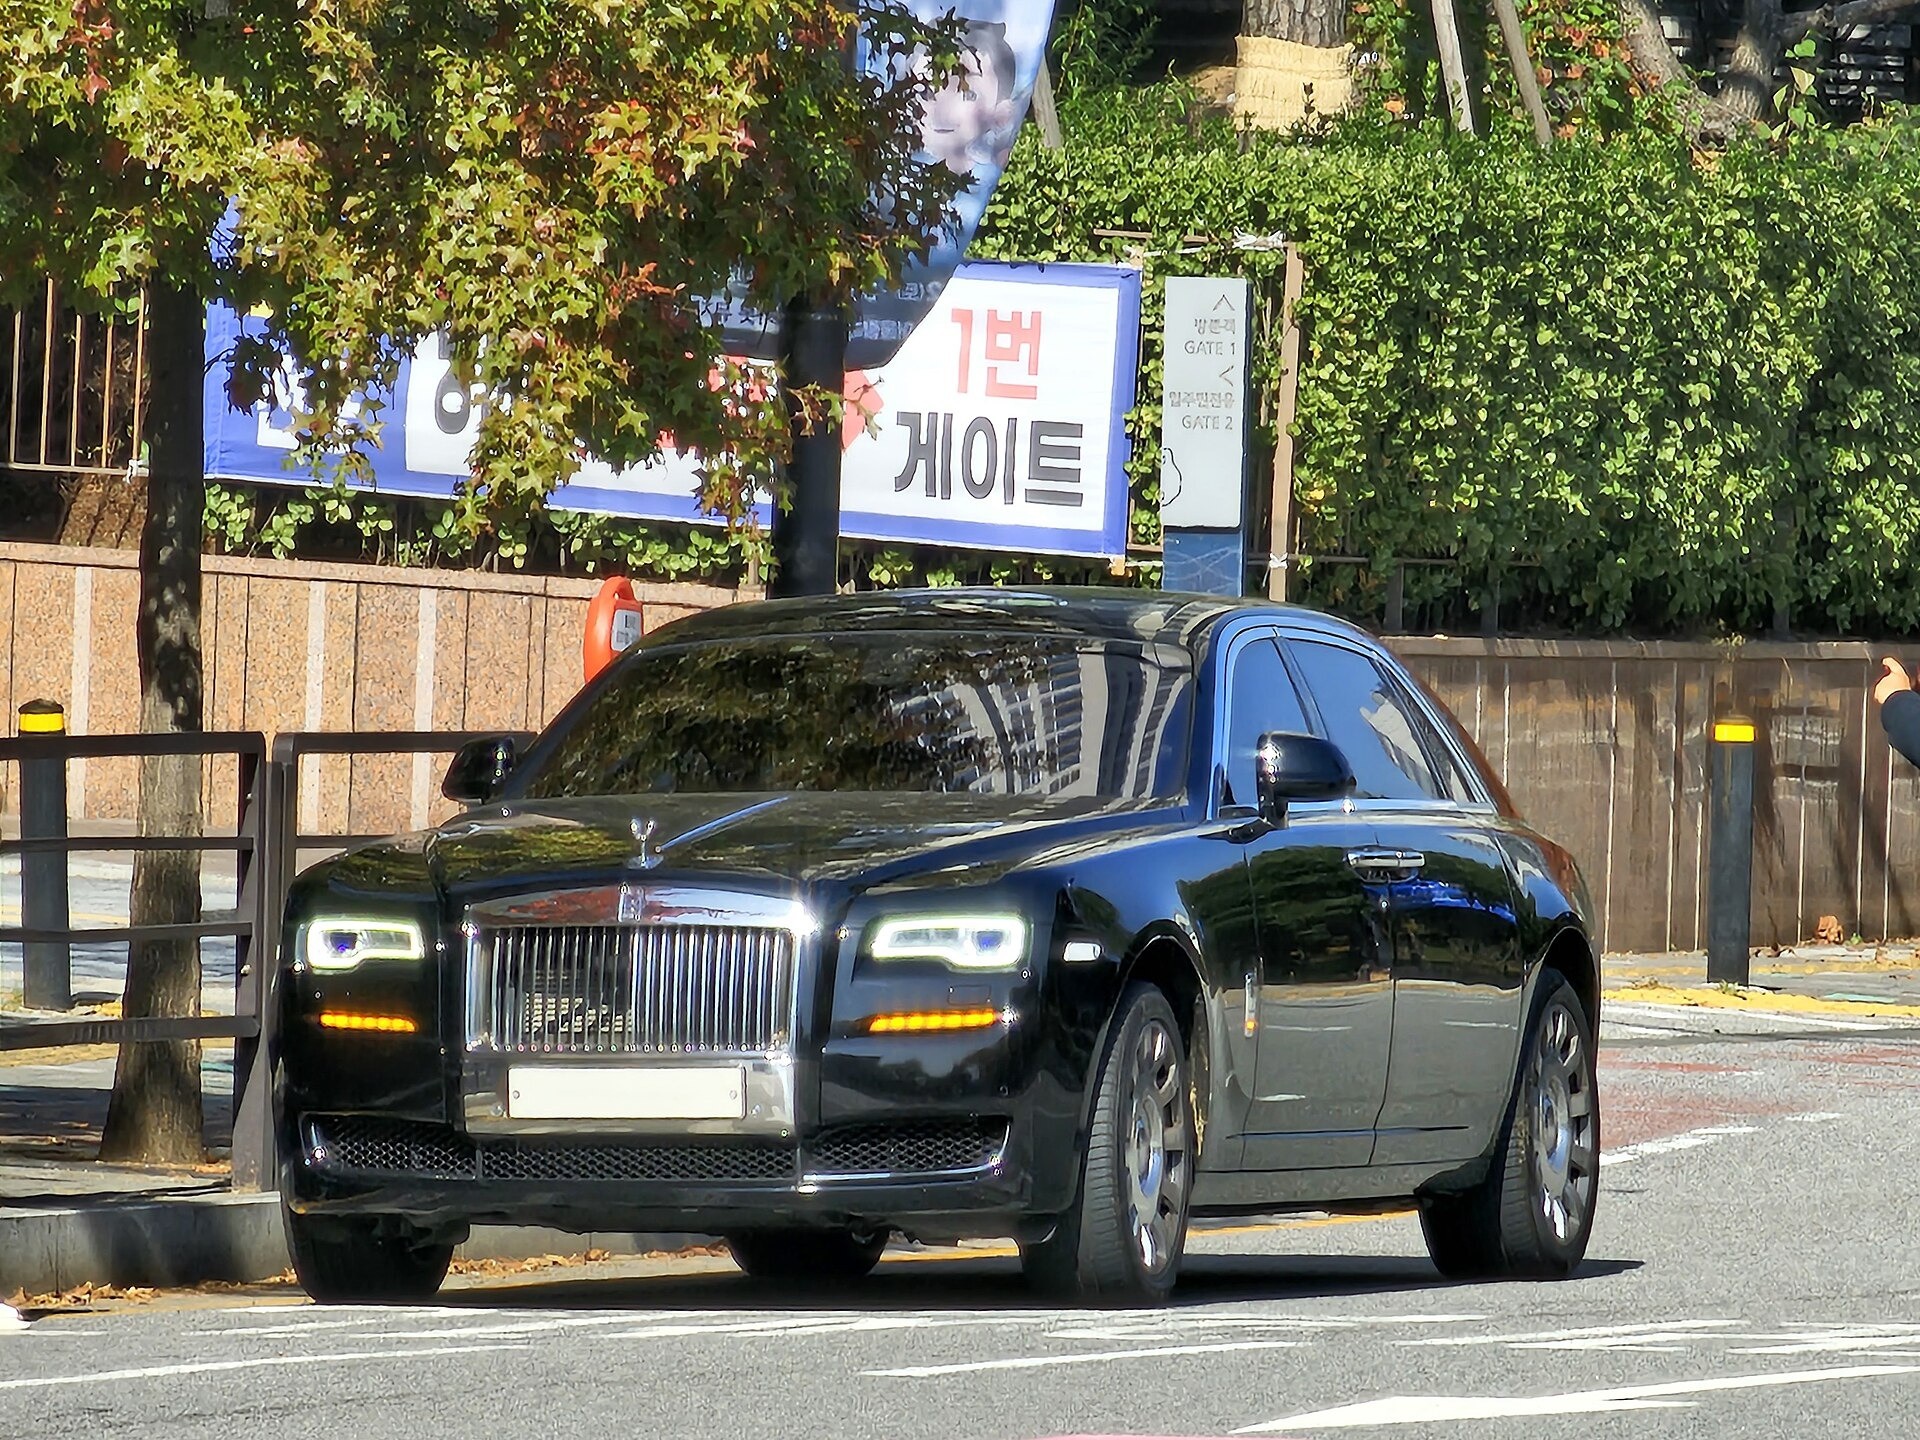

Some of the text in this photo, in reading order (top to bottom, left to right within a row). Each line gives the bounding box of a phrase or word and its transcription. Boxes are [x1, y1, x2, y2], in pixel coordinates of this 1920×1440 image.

[951, 308, 1042, 400] 1번
[1184, 340, 1236, 355] GATE 1
[1182, 415, 1233, 430] GATE 2
[894, 411, 1083, 507] 게이트
